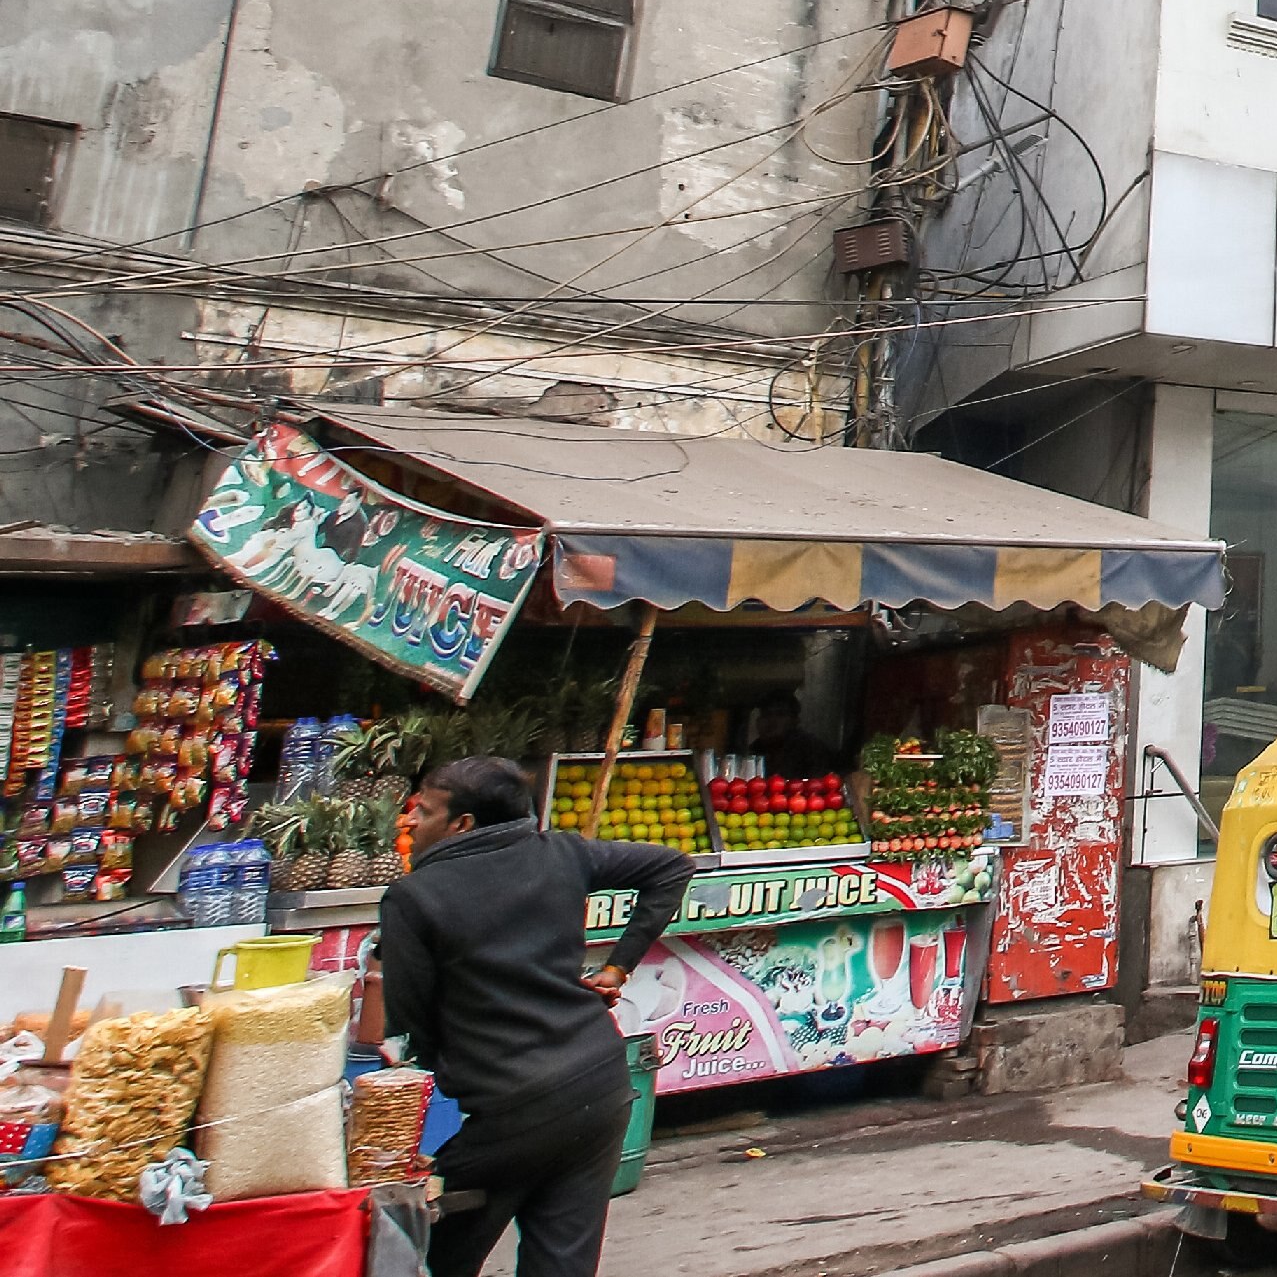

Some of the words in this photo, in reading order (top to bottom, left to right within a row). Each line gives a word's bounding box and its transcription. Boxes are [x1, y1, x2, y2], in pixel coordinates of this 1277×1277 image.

[1051, 720, 1106, 738] 9354090127
[1048, 773, 1103, 790] 9354090127
[683, 999, 730, 1017] Fresh
[658, 1016, 753, 1066] Fruit
